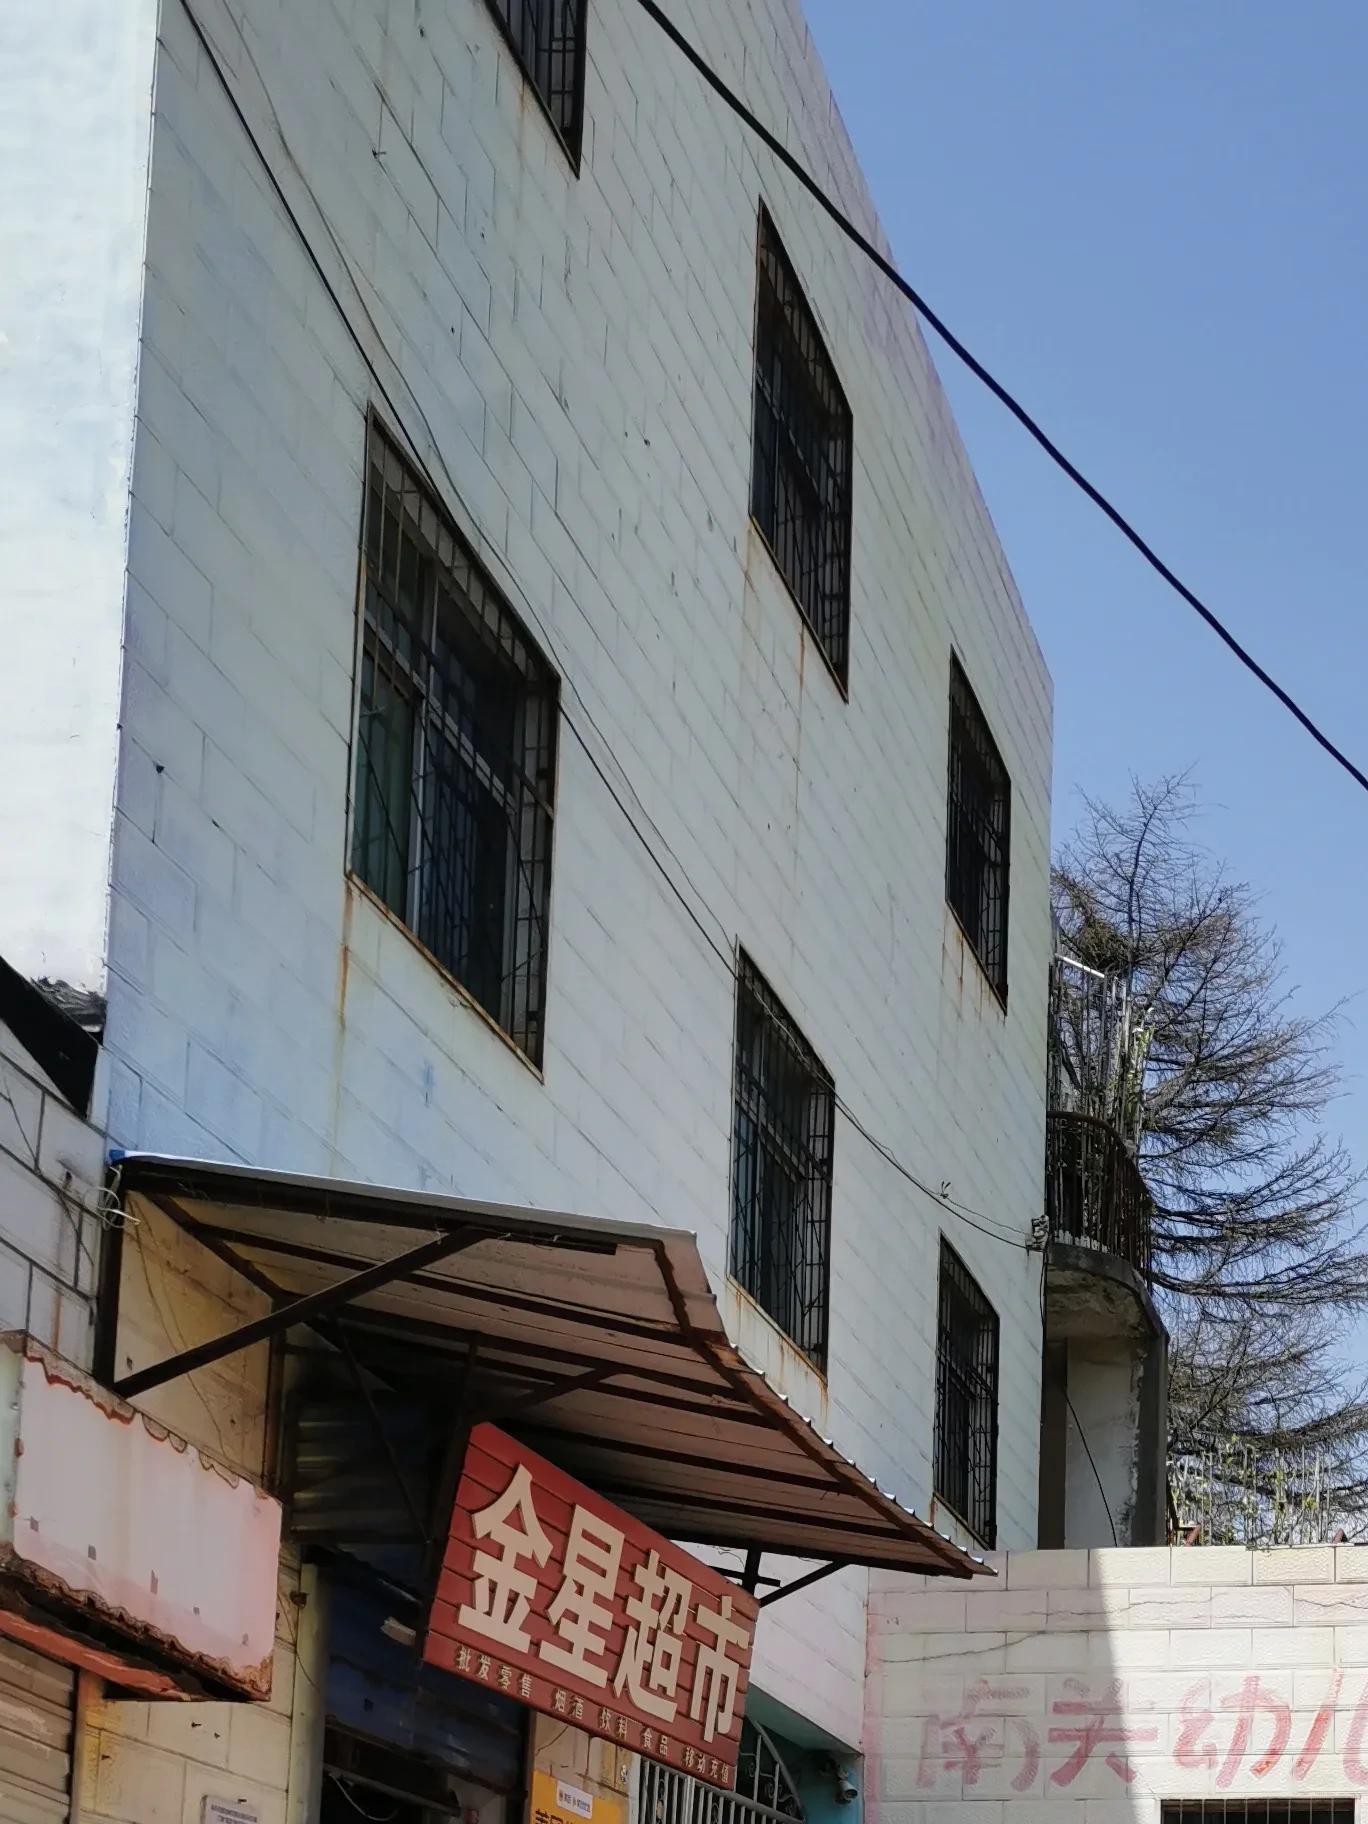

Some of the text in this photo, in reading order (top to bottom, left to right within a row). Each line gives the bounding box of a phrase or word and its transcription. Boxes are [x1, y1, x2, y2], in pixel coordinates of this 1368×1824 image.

[457, 1463, 750, 1743] 金星超市
[456, 1645, 729, 1785] 批发零售 烟酒 饮料 食品 移动充值
